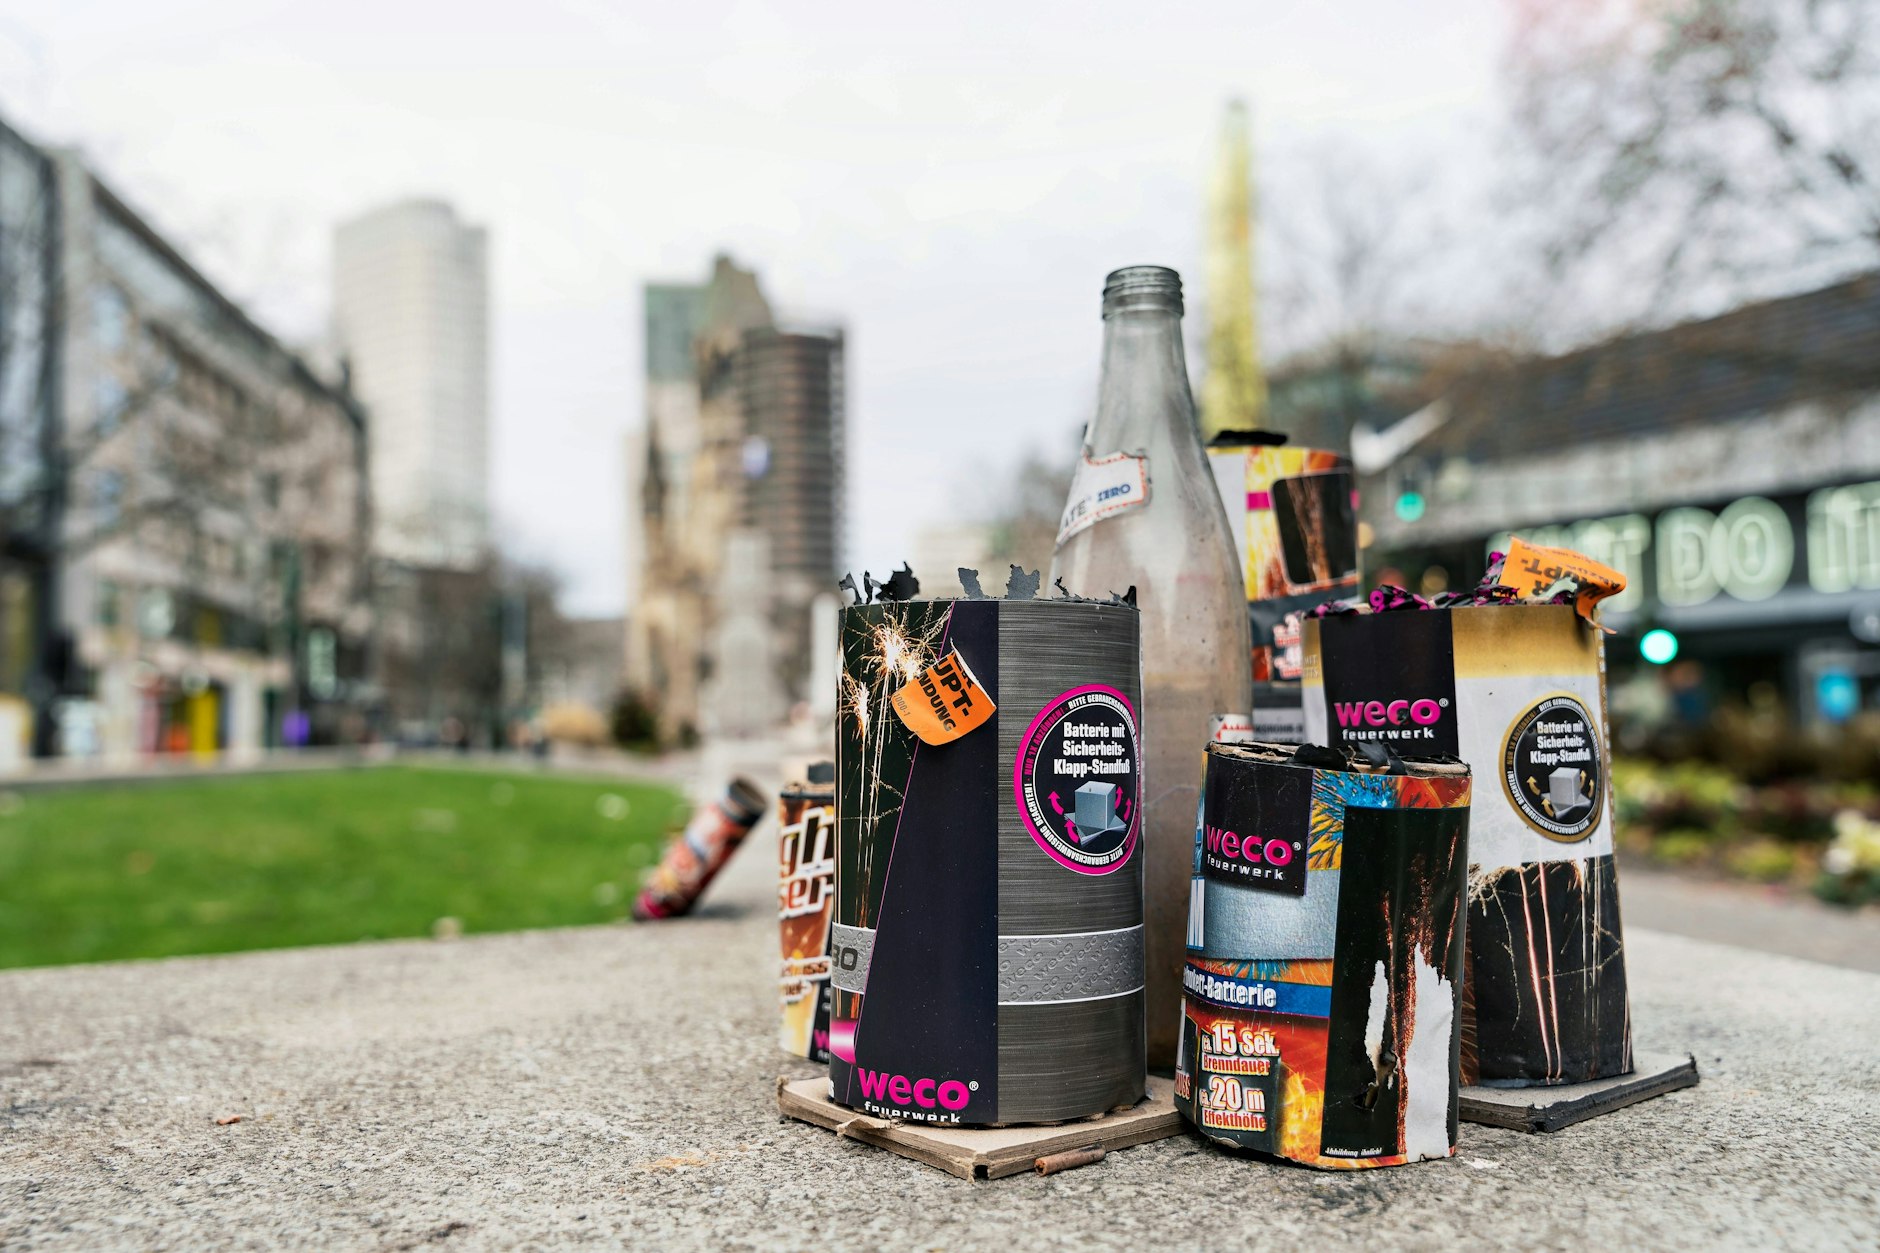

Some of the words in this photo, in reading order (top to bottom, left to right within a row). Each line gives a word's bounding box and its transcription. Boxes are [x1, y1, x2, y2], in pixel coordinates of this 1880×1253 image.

[1656, 496, 1795, 606] DO
[1063, 722, 1109, 738] Batterie
[1112, 722, 1125, 738] mit
[1342, 727, 1434, 740] feuerwerk
[1537, 720, 1572, 734] Batterie
[1572, 720, 1584, 733] mit
[1062, 740, 1125, 756] Sicherheits-
[1537, 734, 1585, 749] Sicherheits-
[1053, 758, 1130, 778] Klapp-Standfuß
[1207, 853, 1284, 880] feuerwerk
[1212, 1022, 1238, 1056] 15
[1239, 1029, 1280, 1056] Sek.
[1203, 1054, 1270, 1074] Brenndauer
[1210, 1076, 1243, 1111] 20
[1245, 1088, 1265, 1112] m
[1203, 1108, 1267, 1131] Effekthöhe
